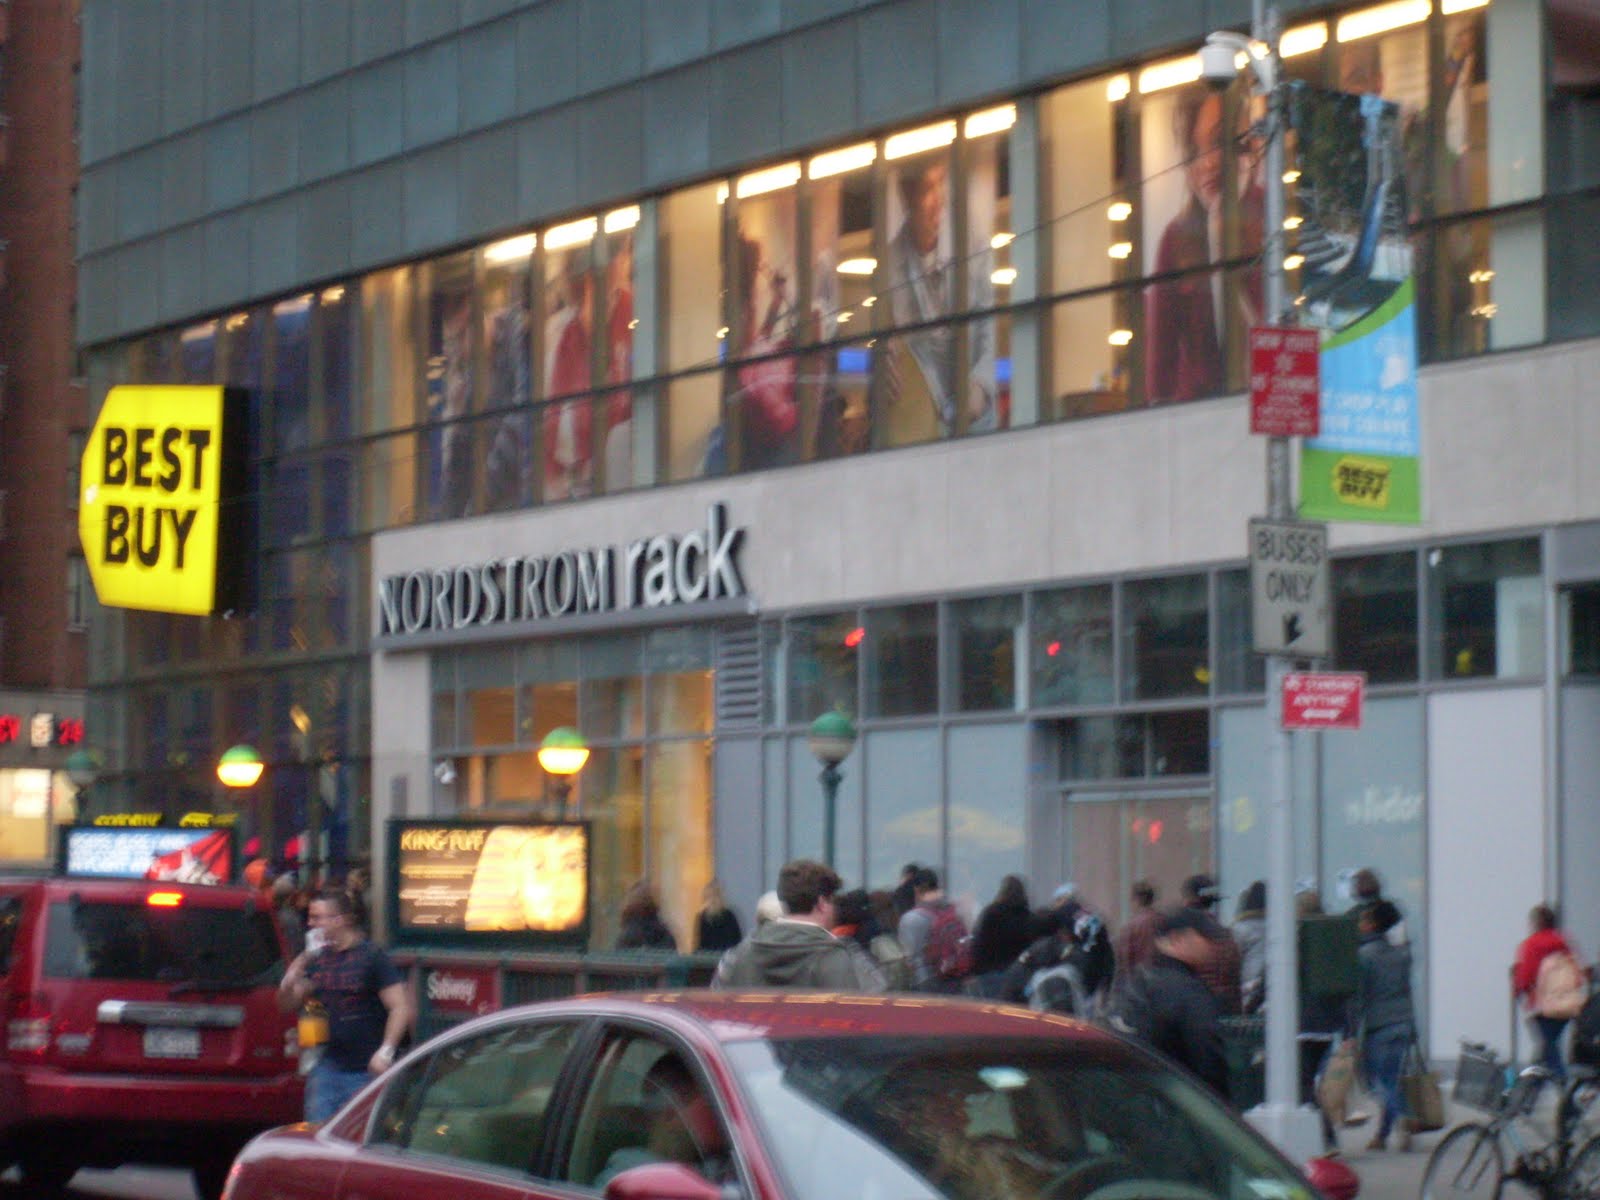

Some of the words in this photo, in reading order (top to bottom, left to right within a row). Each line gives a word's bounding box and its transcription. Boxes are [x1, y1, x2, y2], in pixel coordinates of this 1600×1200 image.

[103, 427, 211, 493] BEST
[1338, 464, 1390, 486] BEST
[1340, 481, 1386, 500] BUY
[104, 504, 198, 570] BUY
[1256, 528, 1321, 566] BUSES
[378, 546, 616, 636] NORDSTROM
[623, 502, 748, 609] rack
[1265, 569, 1315, 603] ONLY
[1292, 693, 1350, 709] ANYTIME
[400, 828, 446, 851] KING
[427, 972, 478, 1006] Subway
